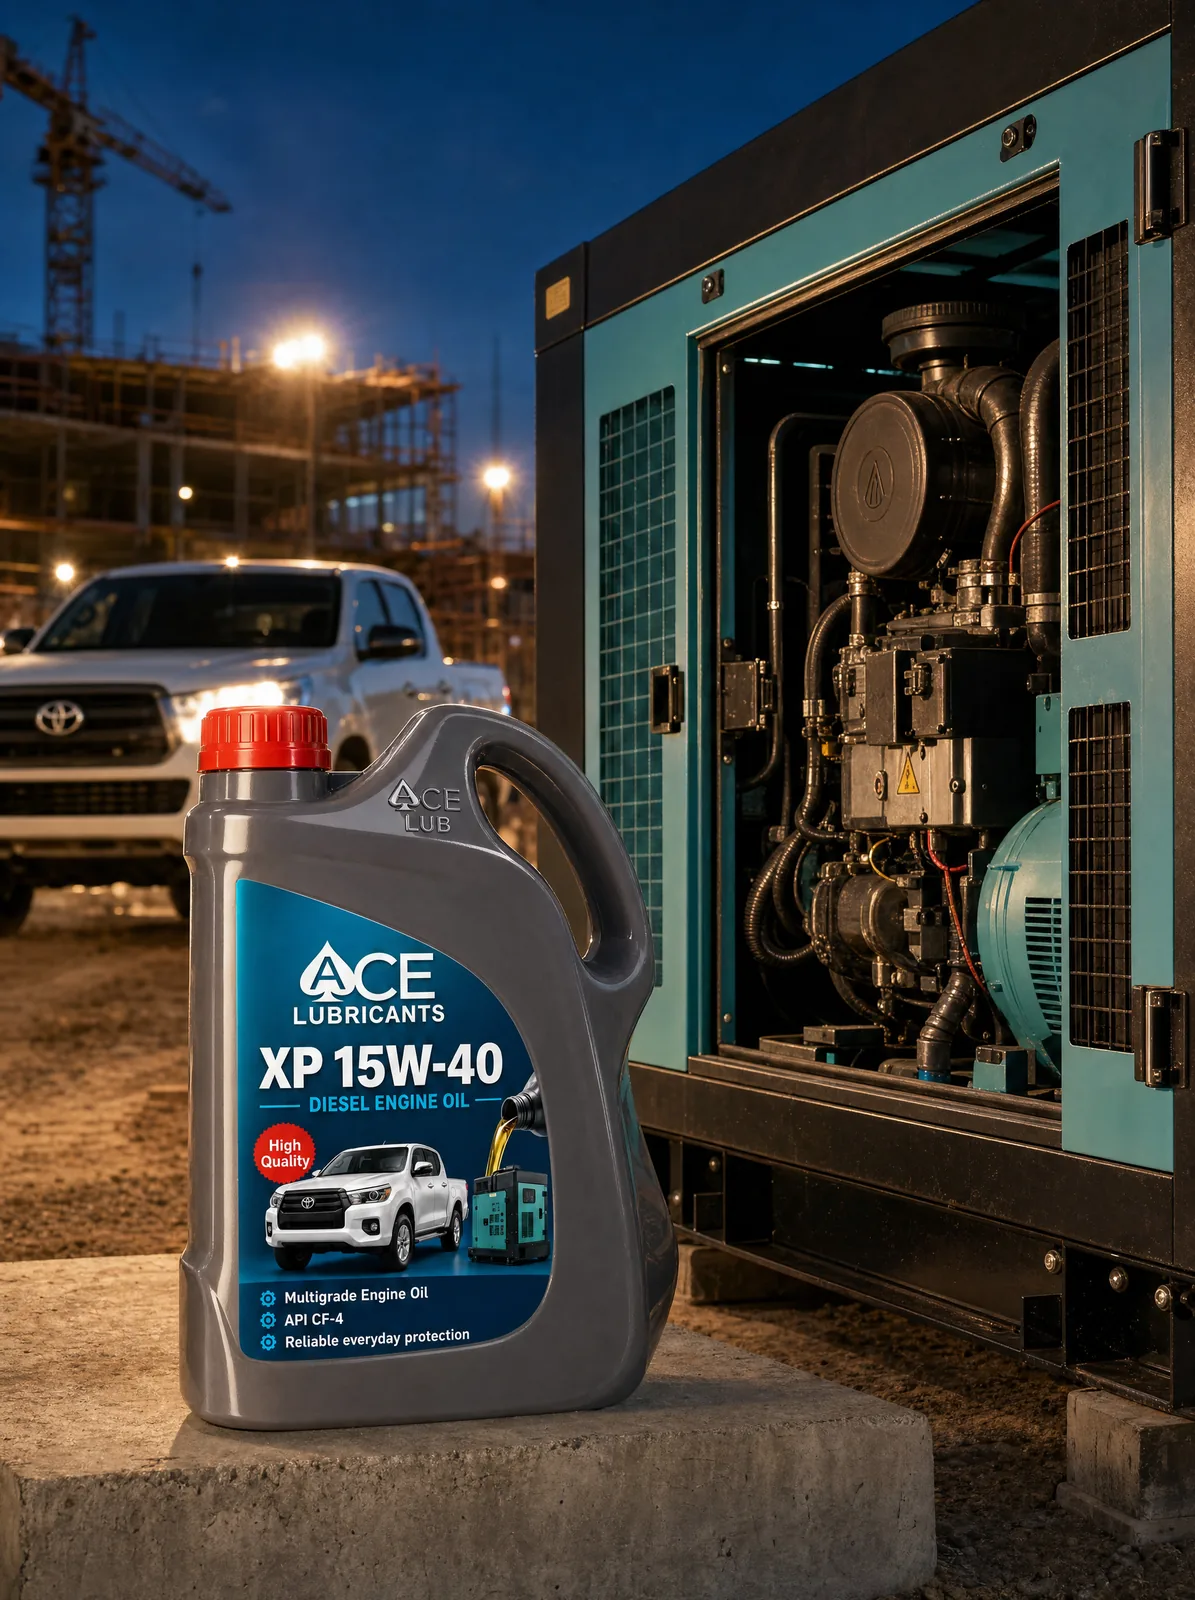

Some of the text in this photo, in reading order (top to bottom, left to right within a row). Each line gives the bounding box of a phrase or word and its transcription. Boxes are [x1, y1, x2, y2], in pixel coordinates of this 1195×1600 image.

[405, 814, 451, 833] LUB
[300, 940, 436, 1003] ACE
[293, 1004, 445, 1025] LUBRICANTS
[259, 1042, 504, 1089] XP 15W-40
[309, 1092, 470, 1113] DIESEL ENGINE OIL
[269, 1138, 301, 1156] High
[260, 1154, 310, 1170] Quality
[285, 1286, 429, 1305] Multigrade Engine Oil
[284, 1313, 344, 1326] API CF-4
[285, 1329, 470, 1349] Reliable everyday protection
